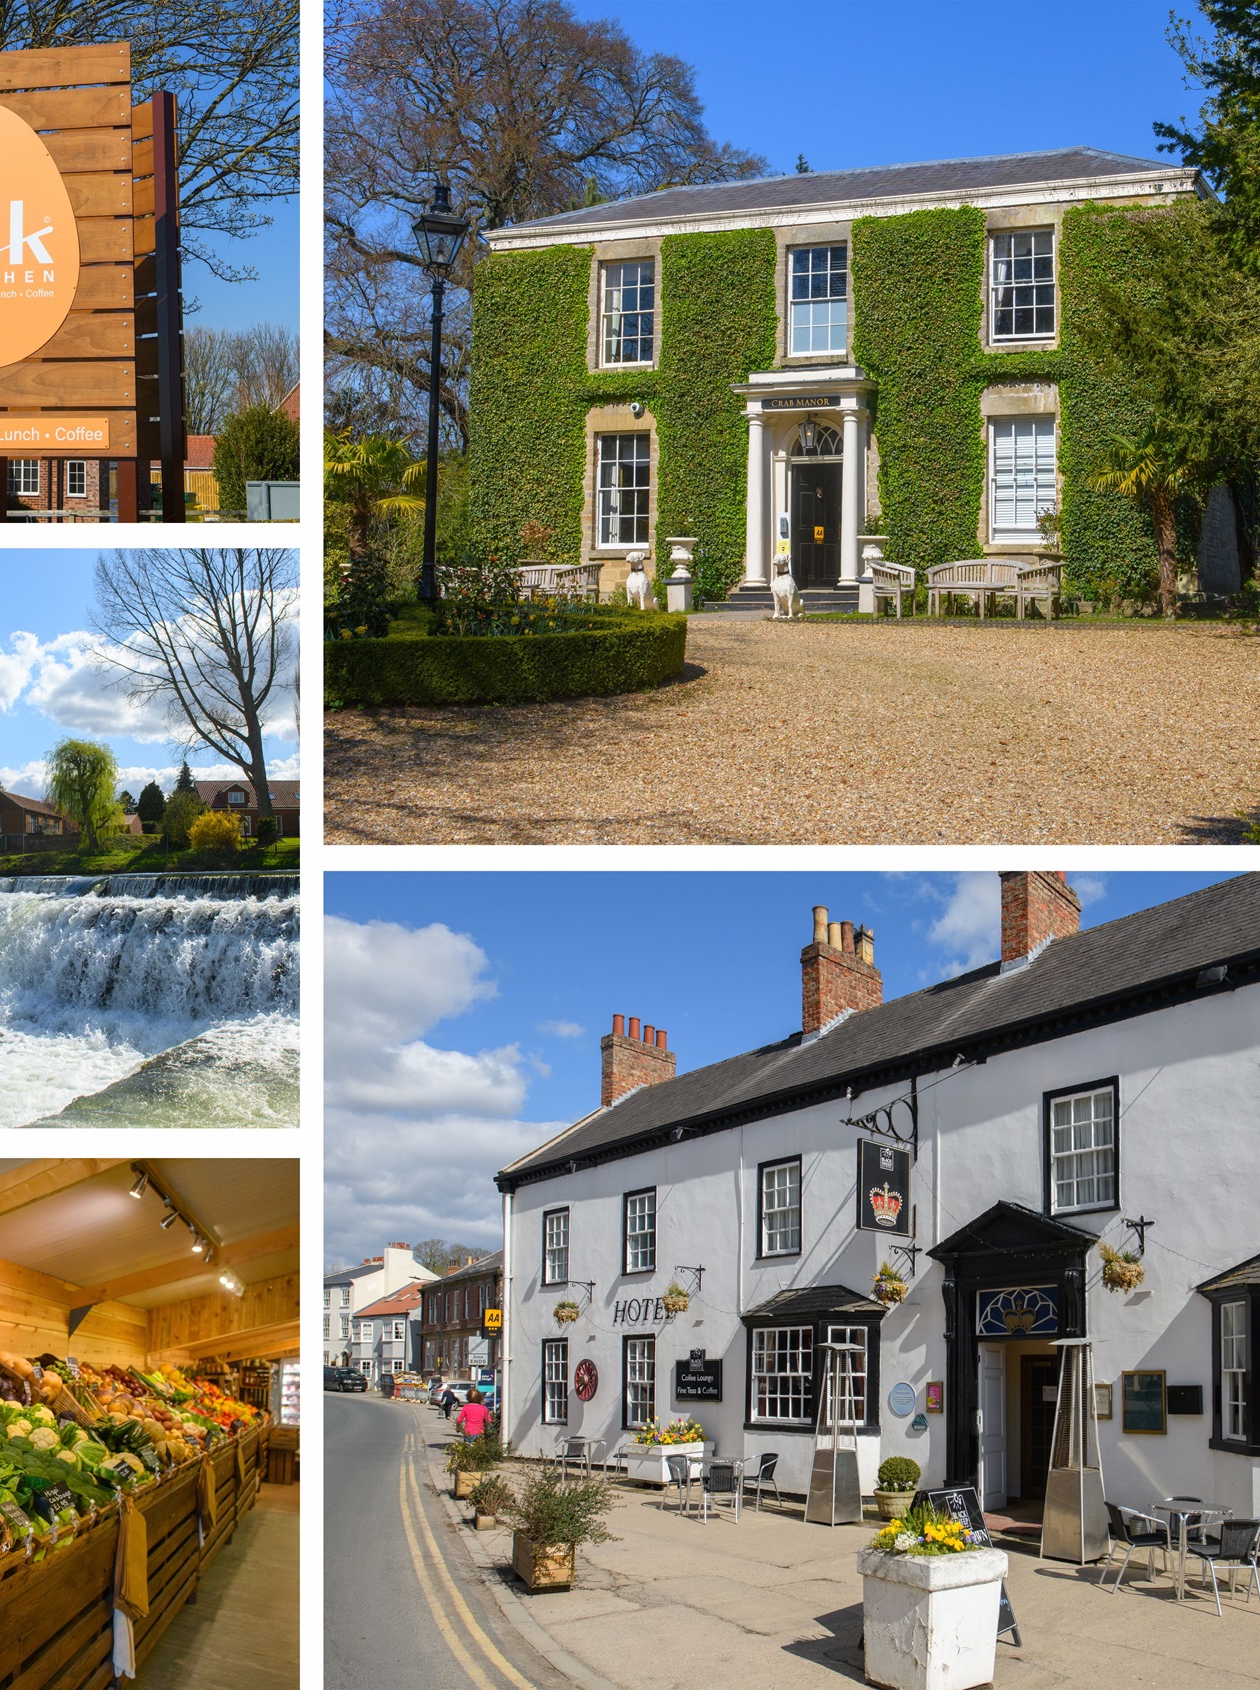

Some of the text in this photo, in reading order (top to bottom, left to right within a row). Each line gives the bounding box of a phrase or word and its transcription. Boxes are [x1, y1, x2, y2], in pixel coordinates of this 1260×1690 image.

[26, 288, 54, 298] Coffee
[796, 398, 830, 406] MANOR
[55, 427, 102, 441] Coffee
[488, 1314, 500, 1322] AA
[697, 1374, 714, 1384] Lounge
